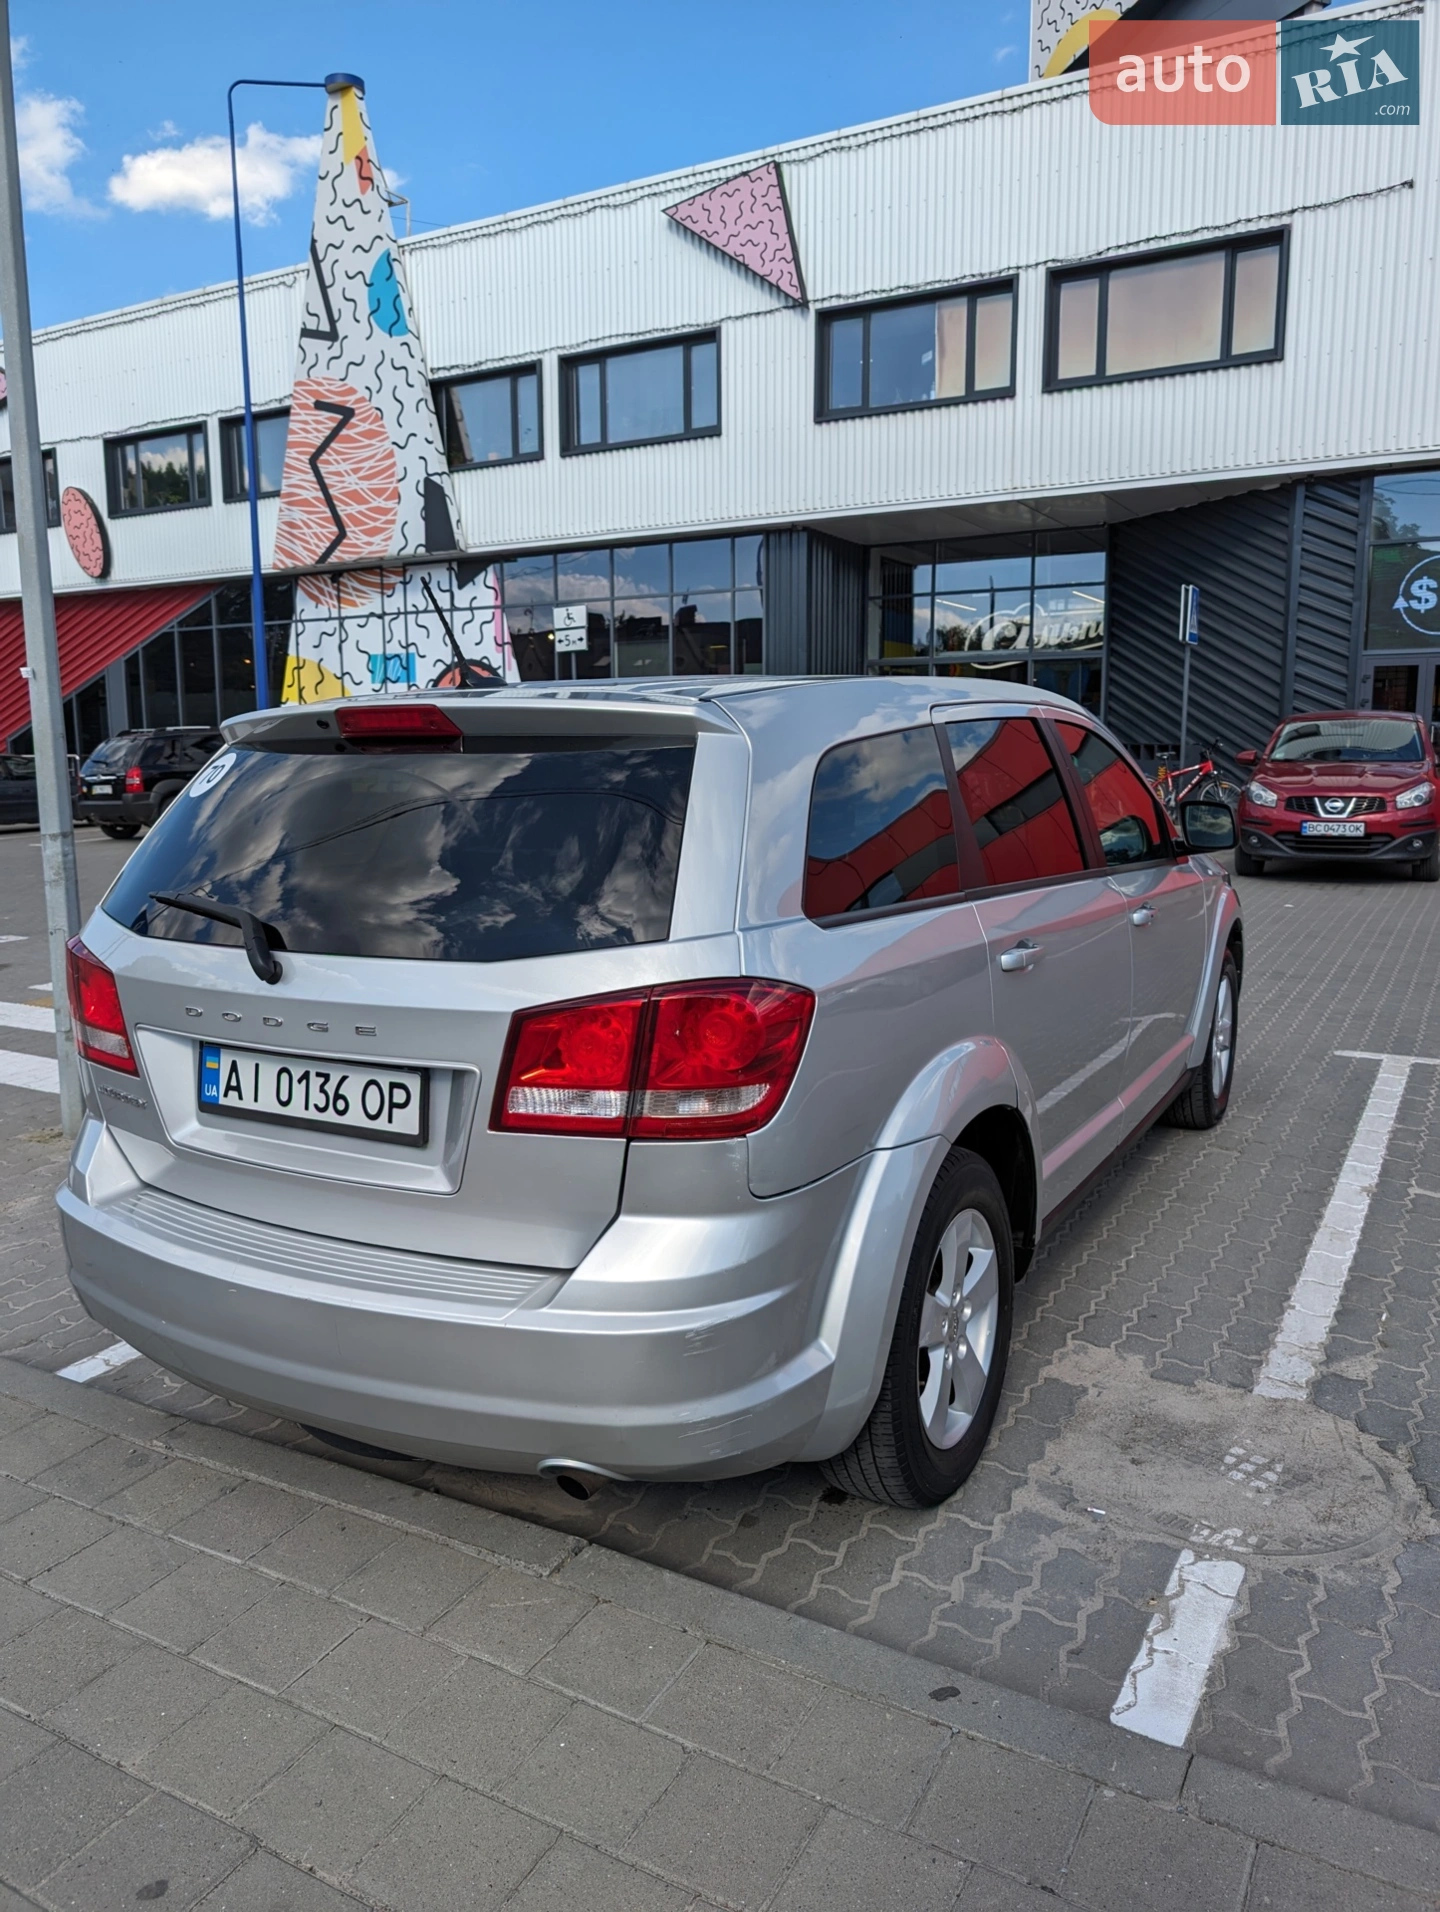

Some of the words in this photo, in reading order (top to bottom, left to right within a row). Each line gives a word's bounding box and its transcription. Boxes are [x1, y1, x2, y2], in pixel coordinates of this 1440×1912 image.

[198, 764, 226, 785] 70
[1308, 823, 1322, 833] BC
[1323, 823, 1347, 833] 0473
[1348, 824, 1363, 834] OK
[184, 1005, 378, 1037] DODGE
[204, 1083, 218, 1098] UA
[223, 1059, 260, 1103] AI
[275, 1066, 351, 1117] 0136
[360, 1078, 412, 1125] OP
